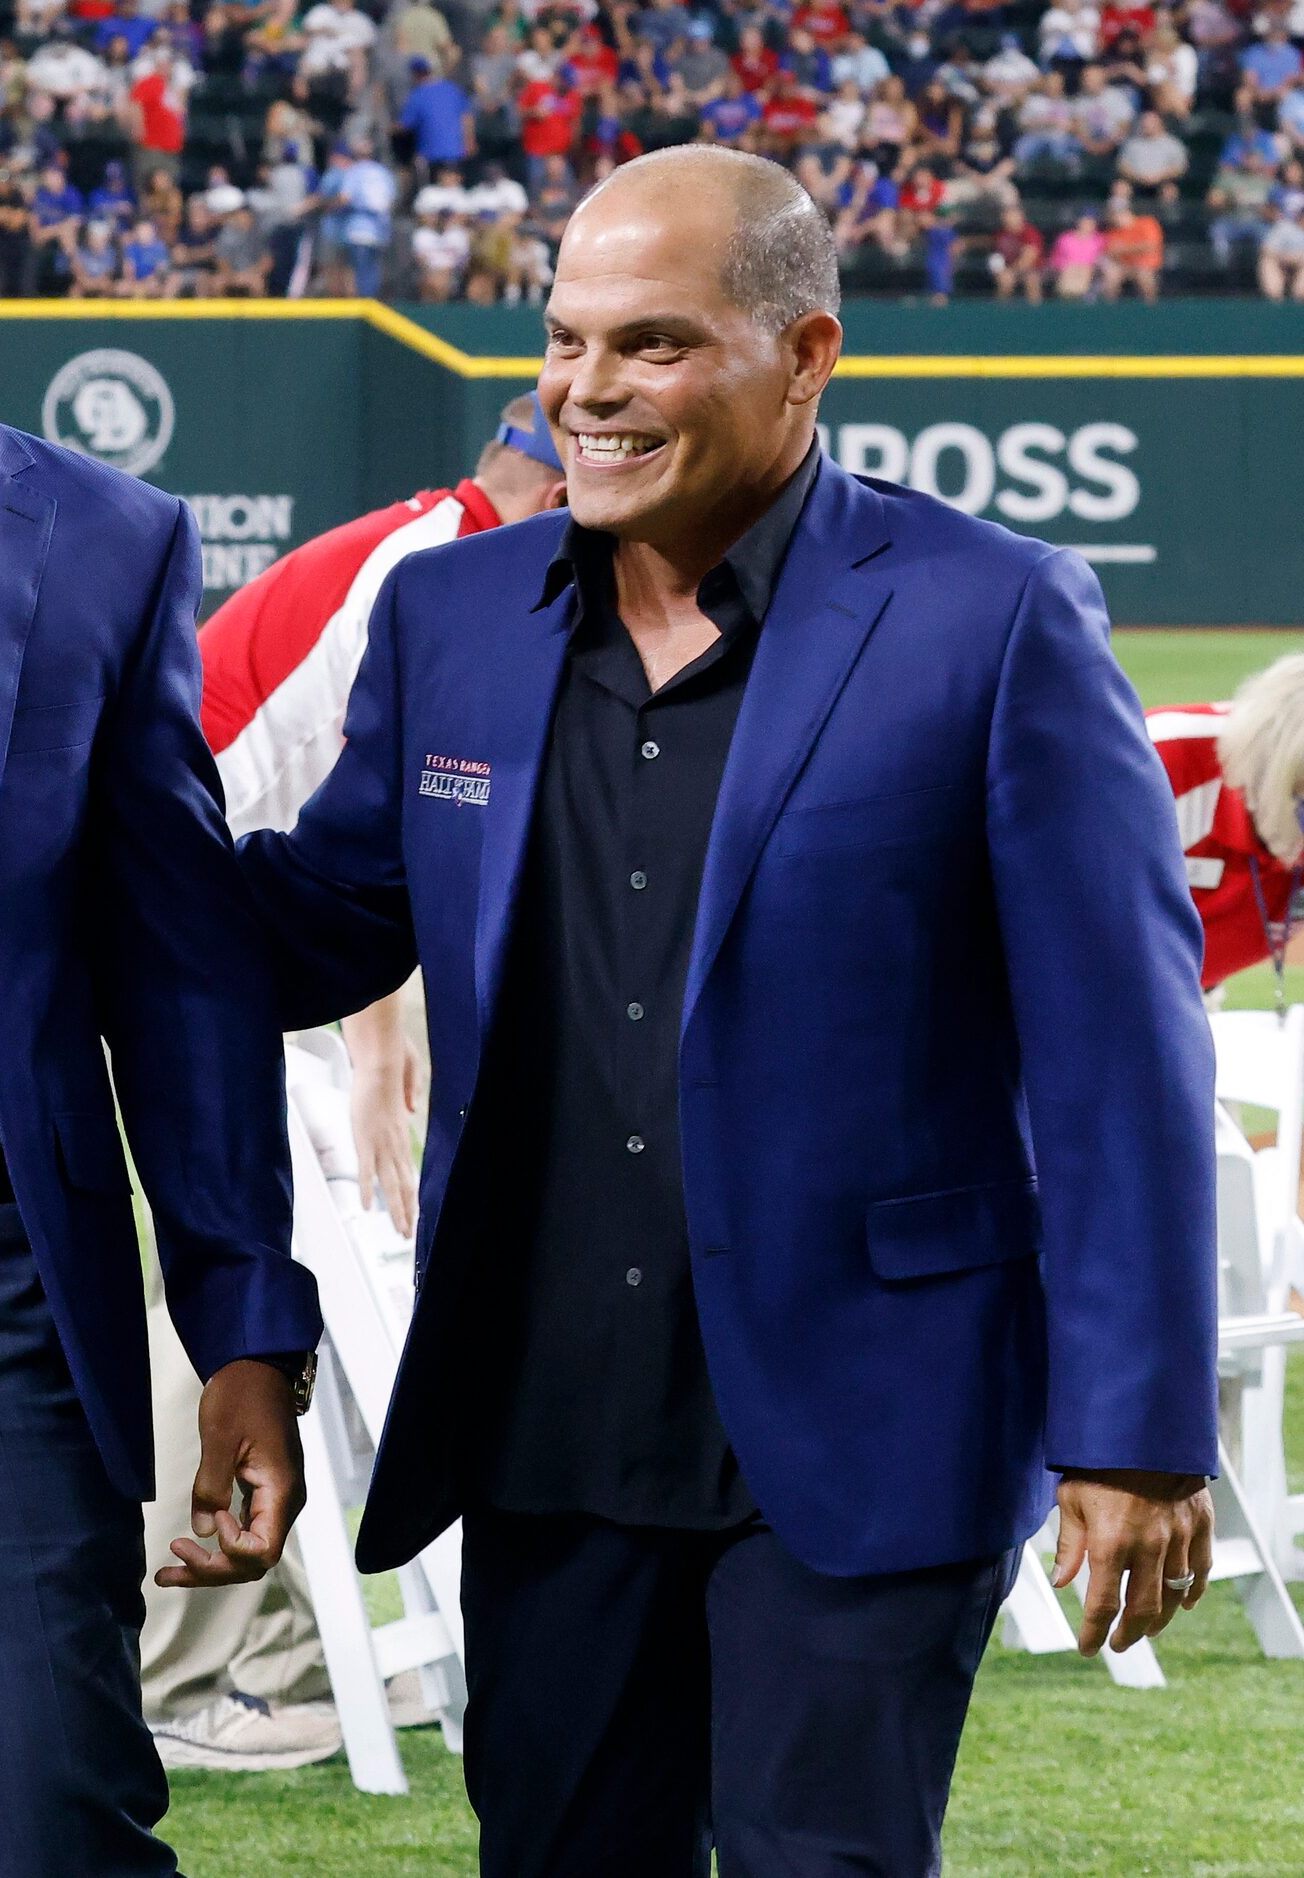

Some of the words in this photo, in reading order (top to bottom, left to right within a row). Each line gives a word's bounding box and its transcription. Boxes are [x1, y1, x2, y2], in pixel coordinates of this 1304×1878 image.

[815, 420, 1142, 521] ROSS
[425, 754, 458, 770] TEXAS
[419, 774, 453, 795] HALL
